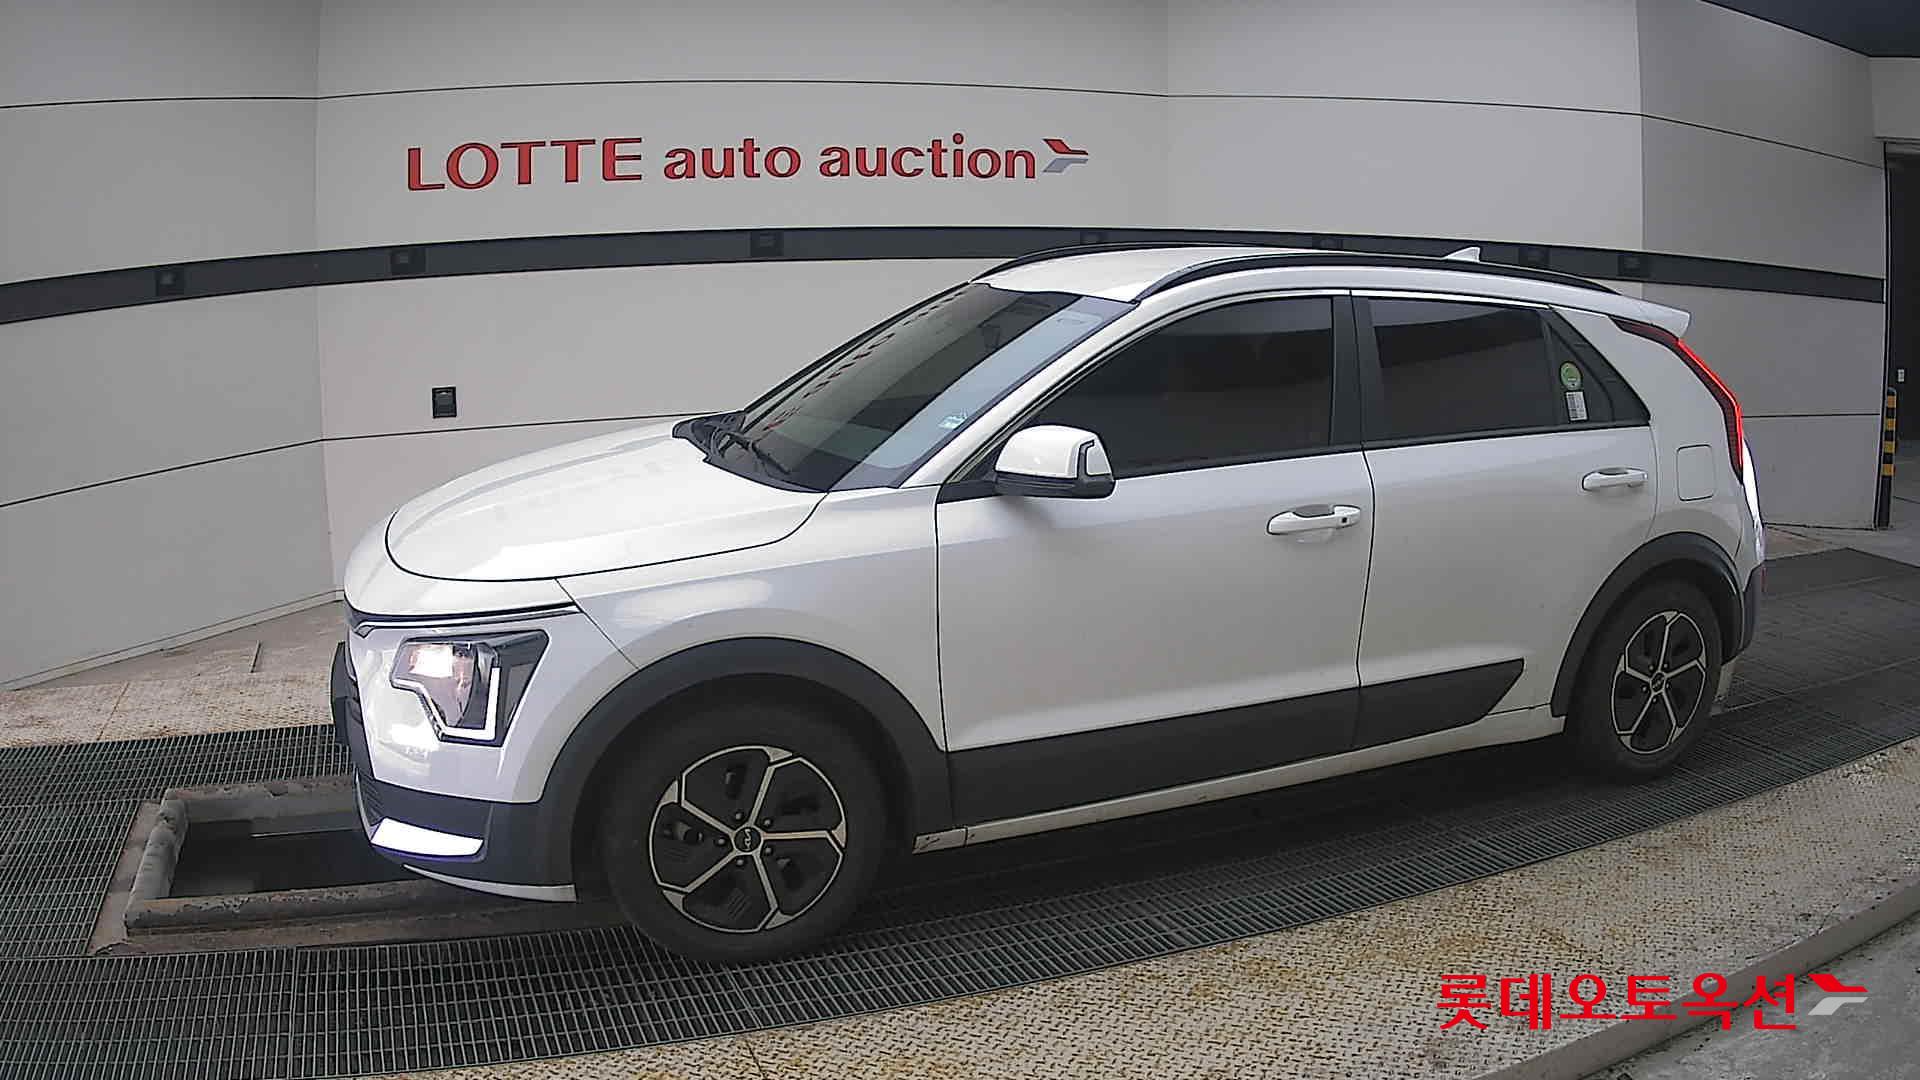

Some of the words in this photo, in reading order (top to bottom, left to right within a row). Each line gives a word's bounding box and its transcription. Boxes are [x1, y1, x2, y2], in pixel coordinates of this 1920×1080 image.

[407, 137, 642, 191] LOTTE
[663, 138, 800, 180] auto
[818, 133, 1036, 179] auction
